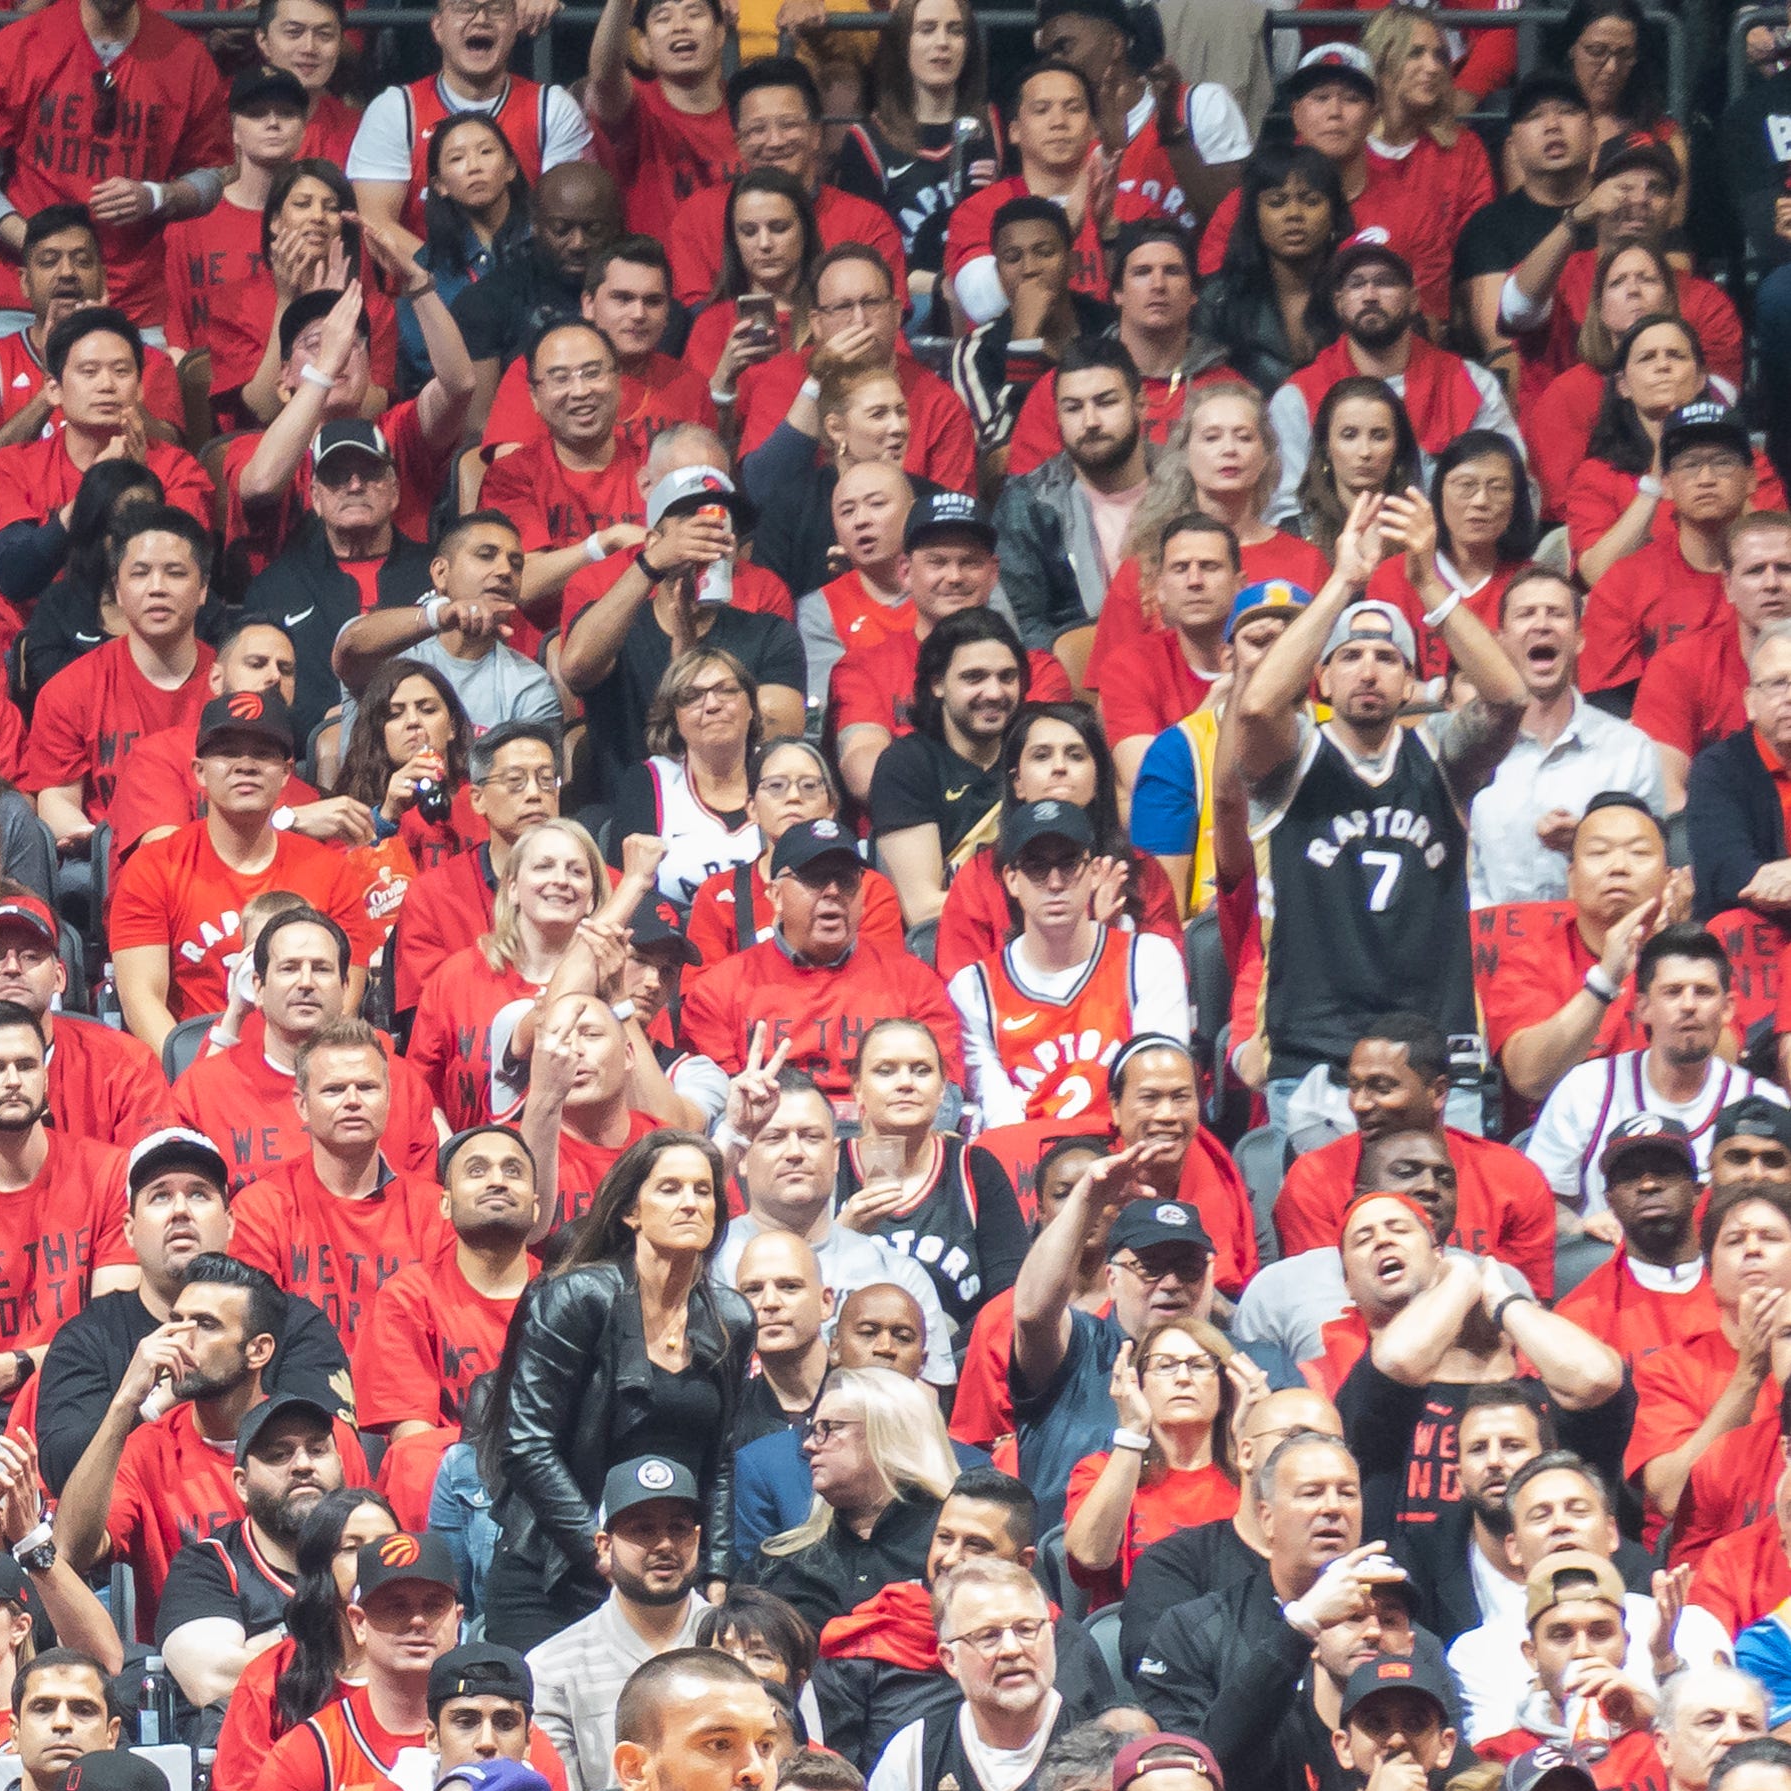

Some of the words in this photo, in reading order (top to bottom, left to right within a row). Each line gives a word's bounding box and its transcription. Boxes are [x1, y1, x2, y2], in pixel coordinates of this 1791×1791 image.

[1308, 806, 1445, 868] RAPTORS
[1361, 850, 1401, 912] 7
[1478, 912, 1525, 937] WE
[231, 1128, 283, 1165] WE
[24, 1226, 91, 1281] THE
[290, 1241, 335, 1285] WE
[1413, 1422, 1458, 1458] WE
